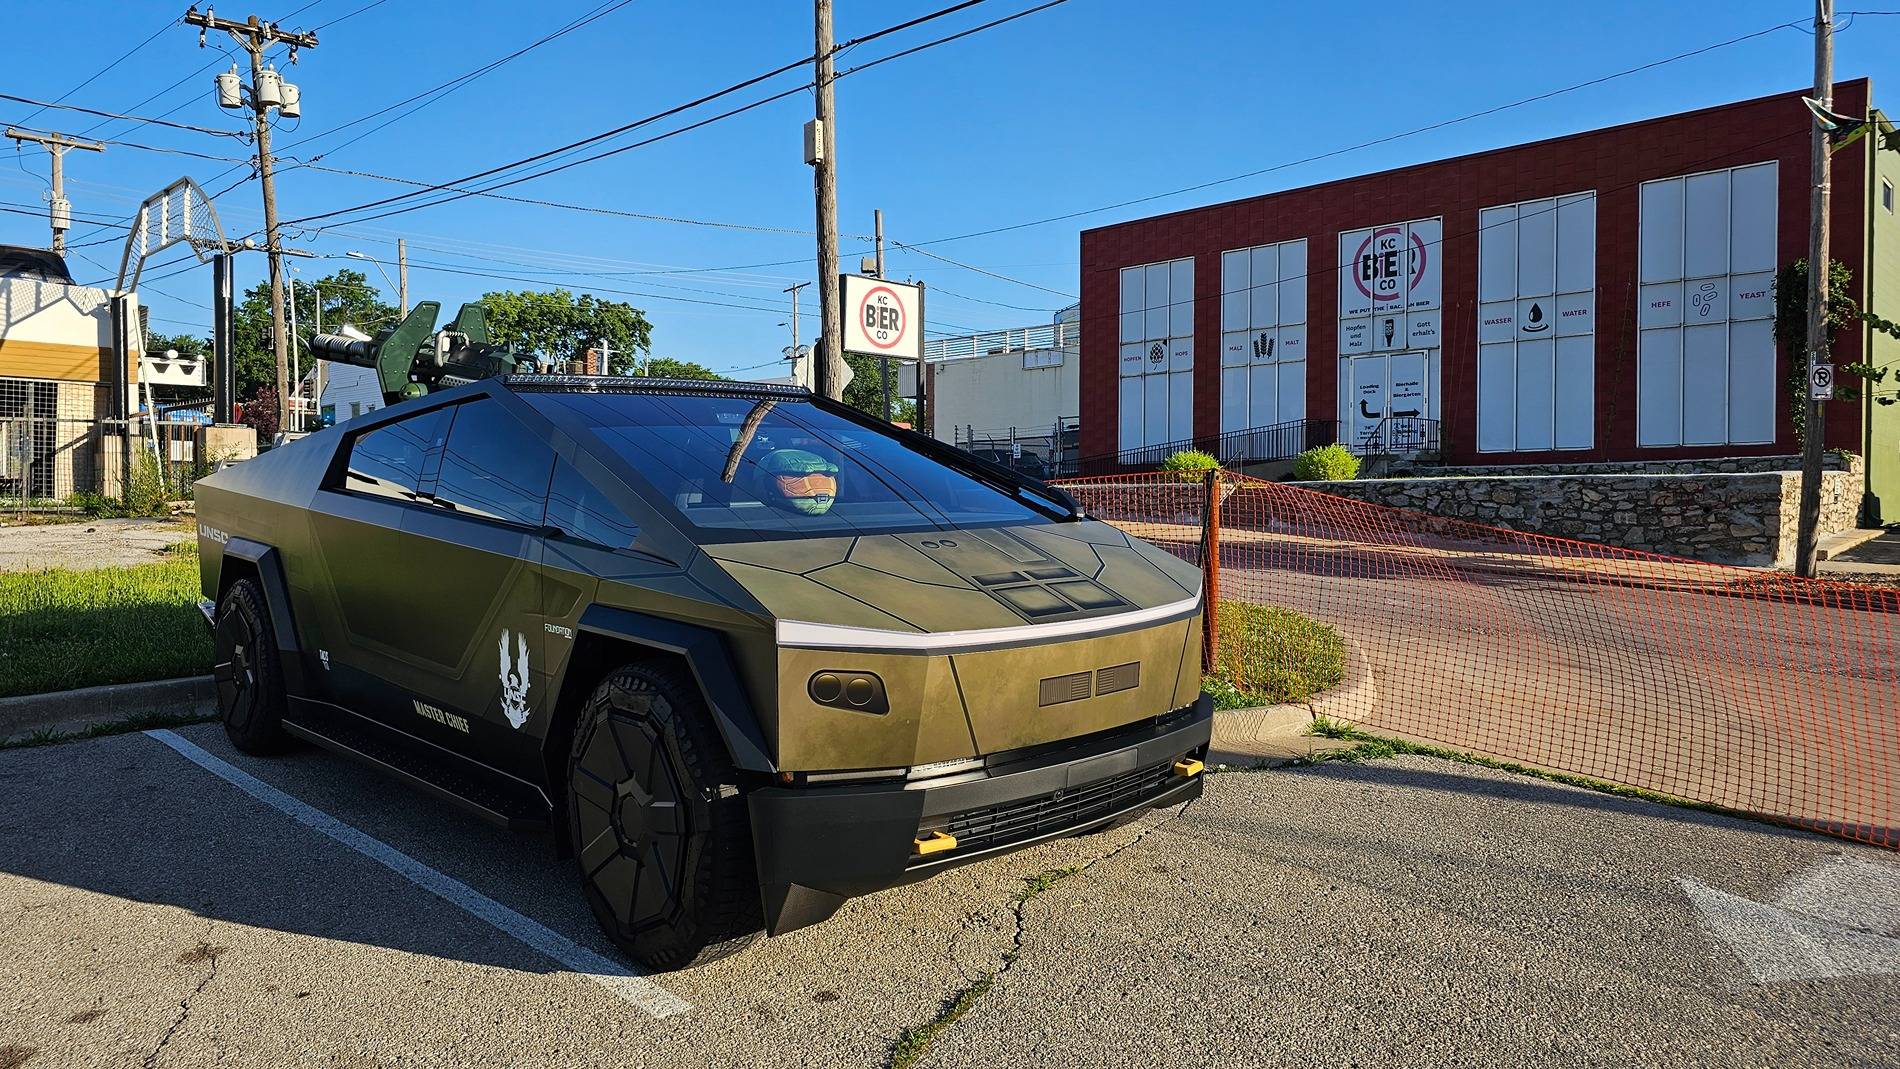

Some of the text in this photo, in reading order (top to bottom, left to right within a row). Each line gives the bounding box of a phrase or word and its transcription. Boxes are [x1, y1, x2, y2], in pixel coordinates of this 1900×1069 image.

[1380, 238, 1396, 250] KC
[1379, 279, 1396, 290] CO
[877, 295, 888, 305] KC
[1651, 292, 1766, 309] HEFE YEAST
[1484, 309, 1587, 326] WASSER WATER
[876, 330, 888, 340] CO
[200, 524, 228, 544] UNSC
[544, 624, 572, 636] FOUNDATION
[413, 699, 469, 734] MASTER CHIEF
